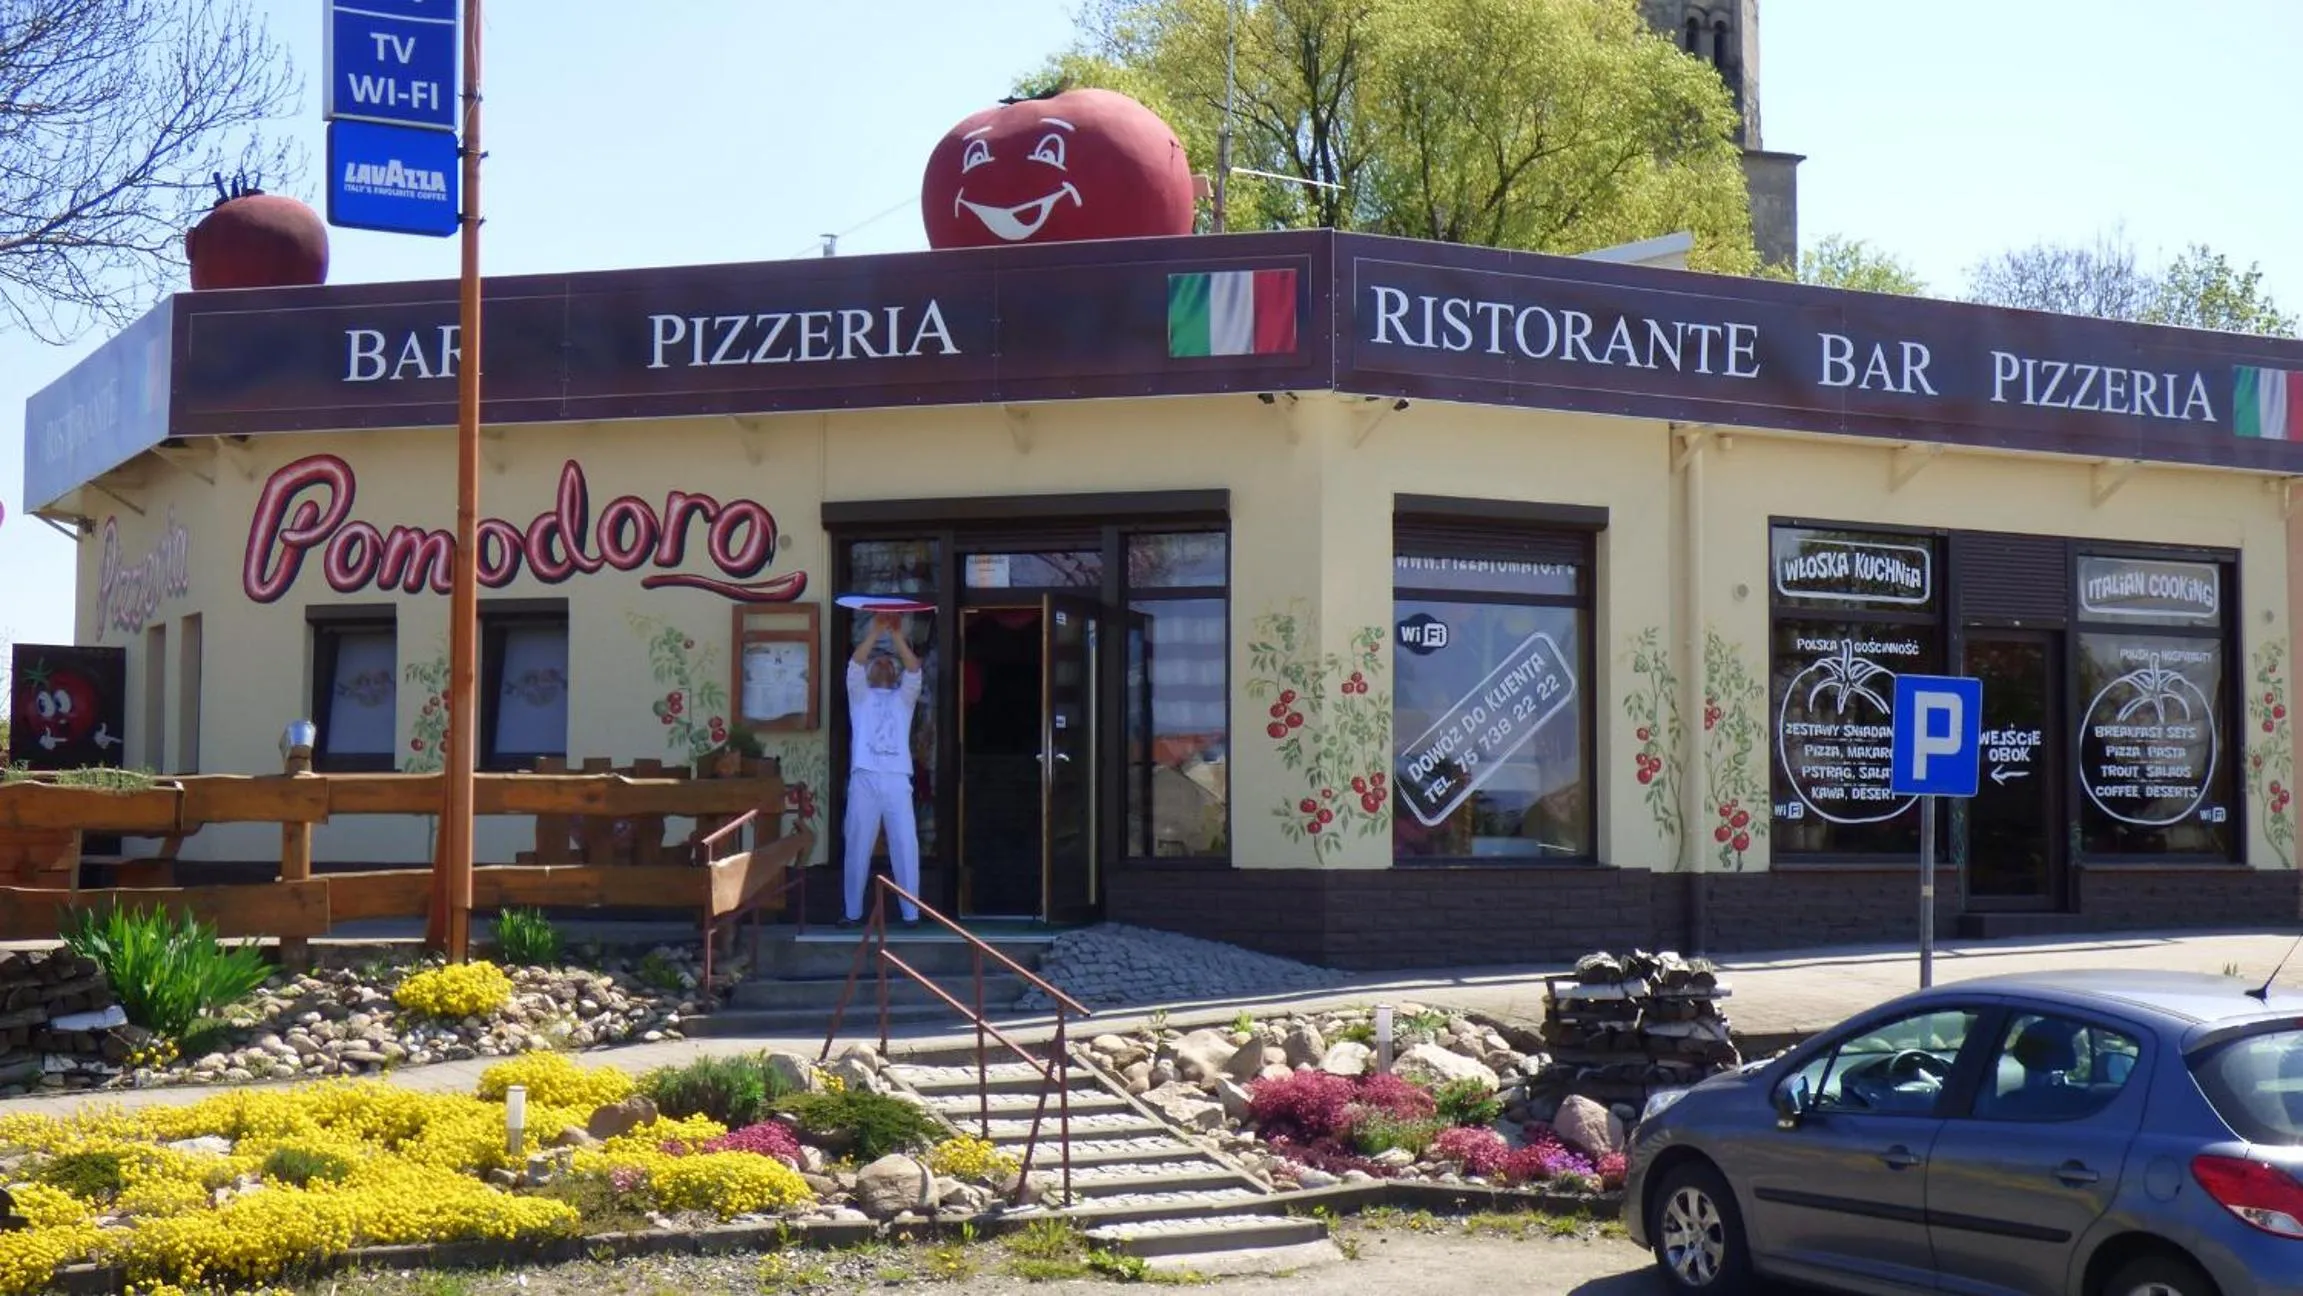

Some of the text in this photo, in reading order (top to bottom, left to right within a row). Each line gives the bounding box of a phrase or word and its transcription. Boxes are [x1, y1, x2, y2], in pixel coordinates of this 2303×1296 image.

[370, 32, 416, 64] TV
[348, 73, 439, 111] WI-FI
[344, 159, 446, 193] LAVAZZA
[647, 299, 962, 369] PIZZERIA
[1370, 285, 2217, 423] RISTORANTE BAR PIZZERIA
[243, 453, 778, 603] Pomodoro
[1785, 552, 1849, 580] WŁOSKA
[1407, 652, 1546, 782] DOWÓZ DO KLIENTA
[1785, 722, 1840, 736] ZESTAWY
[2166, 726, 2197, 739] SETS
[1423, 674, 1561, 803] TEL. 75 738 22 22
[1847, 745, 1893, 759] MAKAR
[1913, 691, 1963, 780] P
[1988, 747, 2031, 762] OBOK
[1859, 766, 1893, 780] SAŁA
[1852, 787, 1896, 800] DESER
